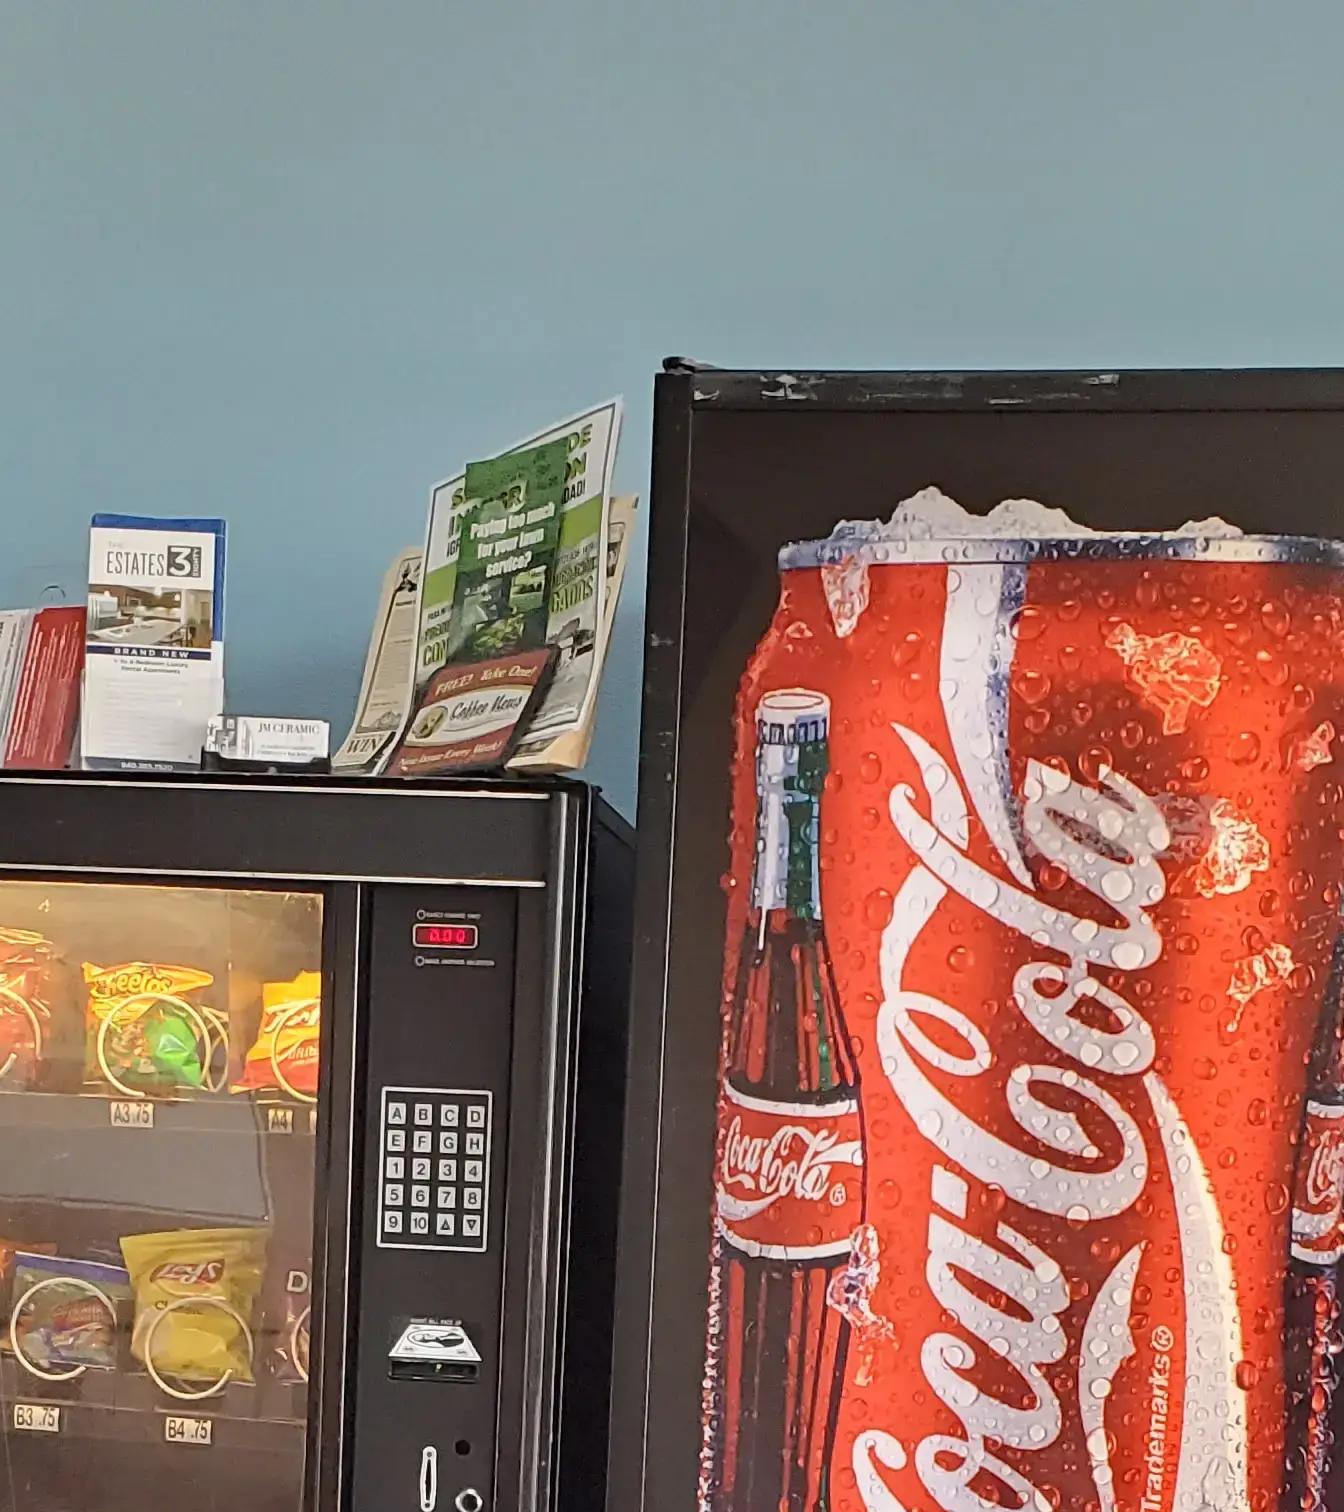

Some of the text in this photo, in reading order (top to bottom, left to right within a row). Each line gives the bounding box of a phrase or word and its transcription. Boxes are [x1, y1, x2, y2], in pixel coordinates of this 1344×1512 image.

[470, 519, 507, 540] Paying
[107, 547, 191, 576] ESTATES 3
[486, 551, 532, 578] service?
[114, 647, 189, 659] BRAND NEW
[480, 667, 507, 681] Take
[450, 693, 524, 722] Coffee News
[258, 723, 320, 734] JM CERAMIC
[348, 736, 379, 754] WIN
[113, 1105, 129, 1124] A3
[392, 1107, 402, 1119] A
[419, 1108, 428, 1120] B
[444, 1109, 455, 1122] C
[471, 1110, 480, 1123] D
[271, 1110, 287, 1130] A4
[392, 1134, 401, 1146] E
[418, 1136, 427, 1148] F
[443, 1137, 454, 1149] G
[470, 1137, 480, 1150] H
[722, 1115, 840, 1201] Coca-Cola
[393, 1162, 399, 1174] 1
[416, 1163, 426, 1175] 2
[443, 1164, 452, 1176] 3
[468, 1165, 478, 1177] 4
[390, 1189, 399, 1201] 5
[416, 1190, 425, 1202] 6
[441, 1191, 451, 1203] 7
[468, 1192, 477, 1205] 8
[388, 1216, 398, 1228] 9
[413, 1217, 427, 1229] 10
[16, 1407, 55, 1427] B3 .75
[168, 1420, 208, 1440] B4 .75
